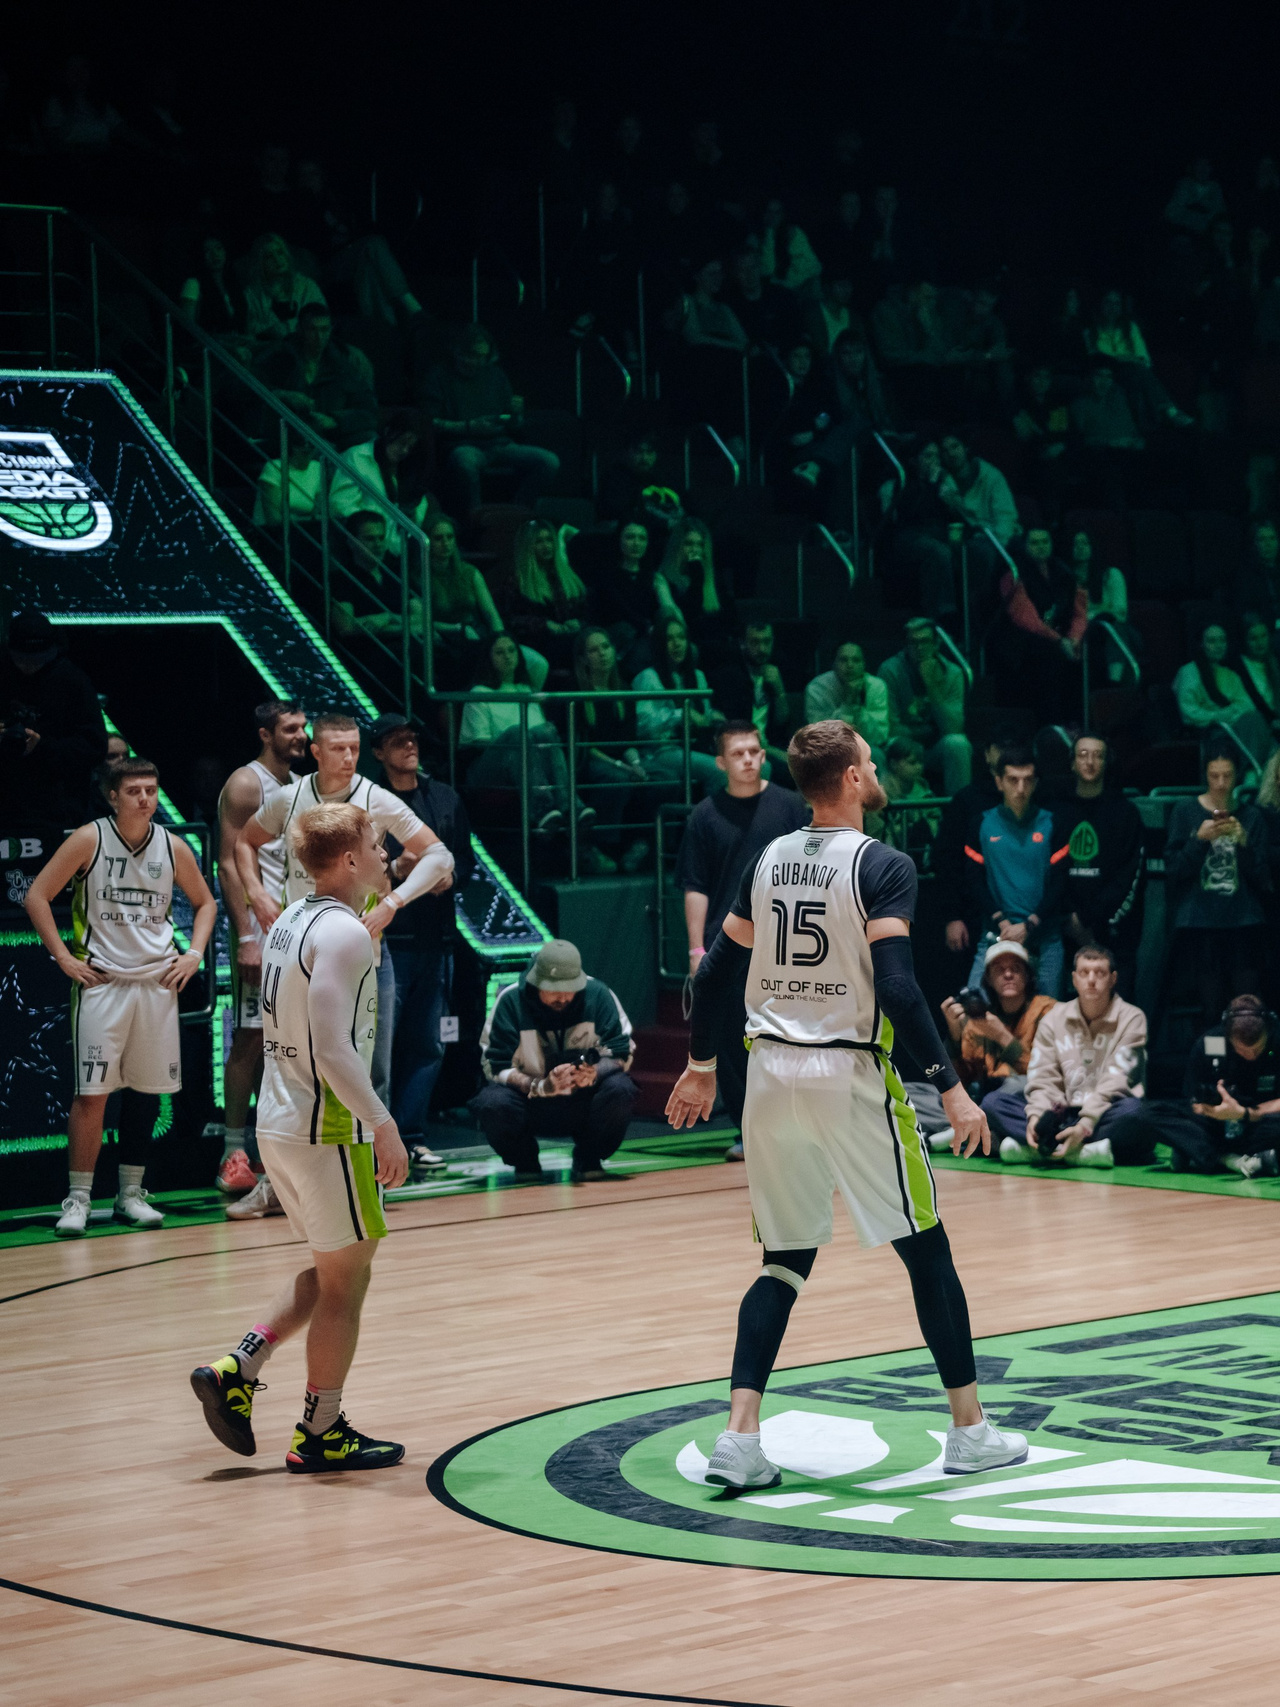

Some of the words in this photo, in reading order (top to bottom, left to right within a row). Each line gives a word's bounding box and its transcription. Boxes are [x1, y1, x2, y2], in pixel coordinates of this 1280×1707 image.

[0, 469, 86, 487] EDIA
[0, 486, 91, 500] ASKET
[105, 856, 128, 878] 77
[772, 862, 838, 890] GUBANOV
[771, 899, 829, 967] 15
[761, 978, 783, 992] OUT
[788, 981, 811, 993] OF
[814, 983, 847, 995] REC
[82, 1061, 108, 1082] 77
